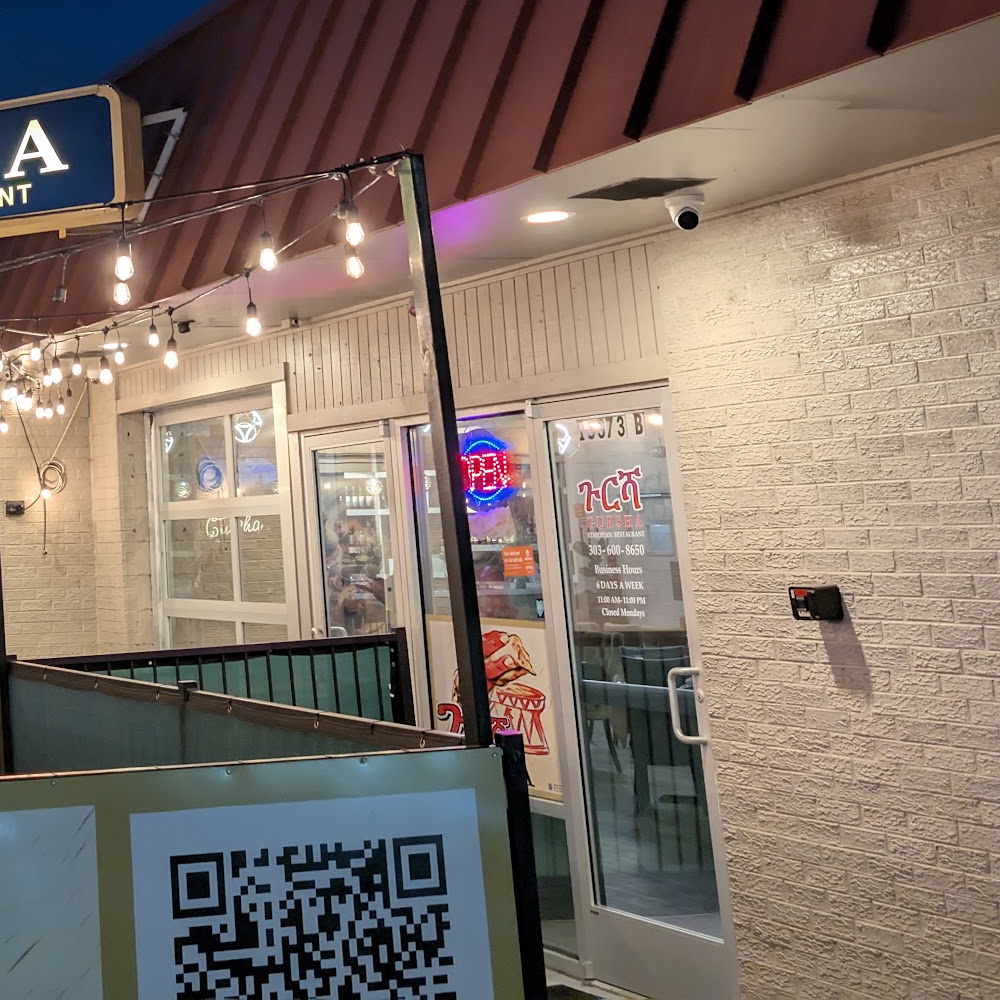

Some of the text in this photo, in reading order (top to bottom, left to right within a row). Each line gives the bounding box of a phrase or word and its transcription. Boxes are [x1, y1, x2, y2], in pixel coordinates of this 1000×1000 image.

[633, 413, 644, 435] B
[577, 465, 643, 513] ጉርሻ
[586, 514, 644, 529] GURSHA
[613, 530, 645, 538] RESTAURANT
[594, 564, 643, 575] Business Hours
[596, 580, 644, 590] 6 DAYS A WEEK
[636, 597, 646, 605] PM
[601, 607, 645, 619] Closed Mondays
